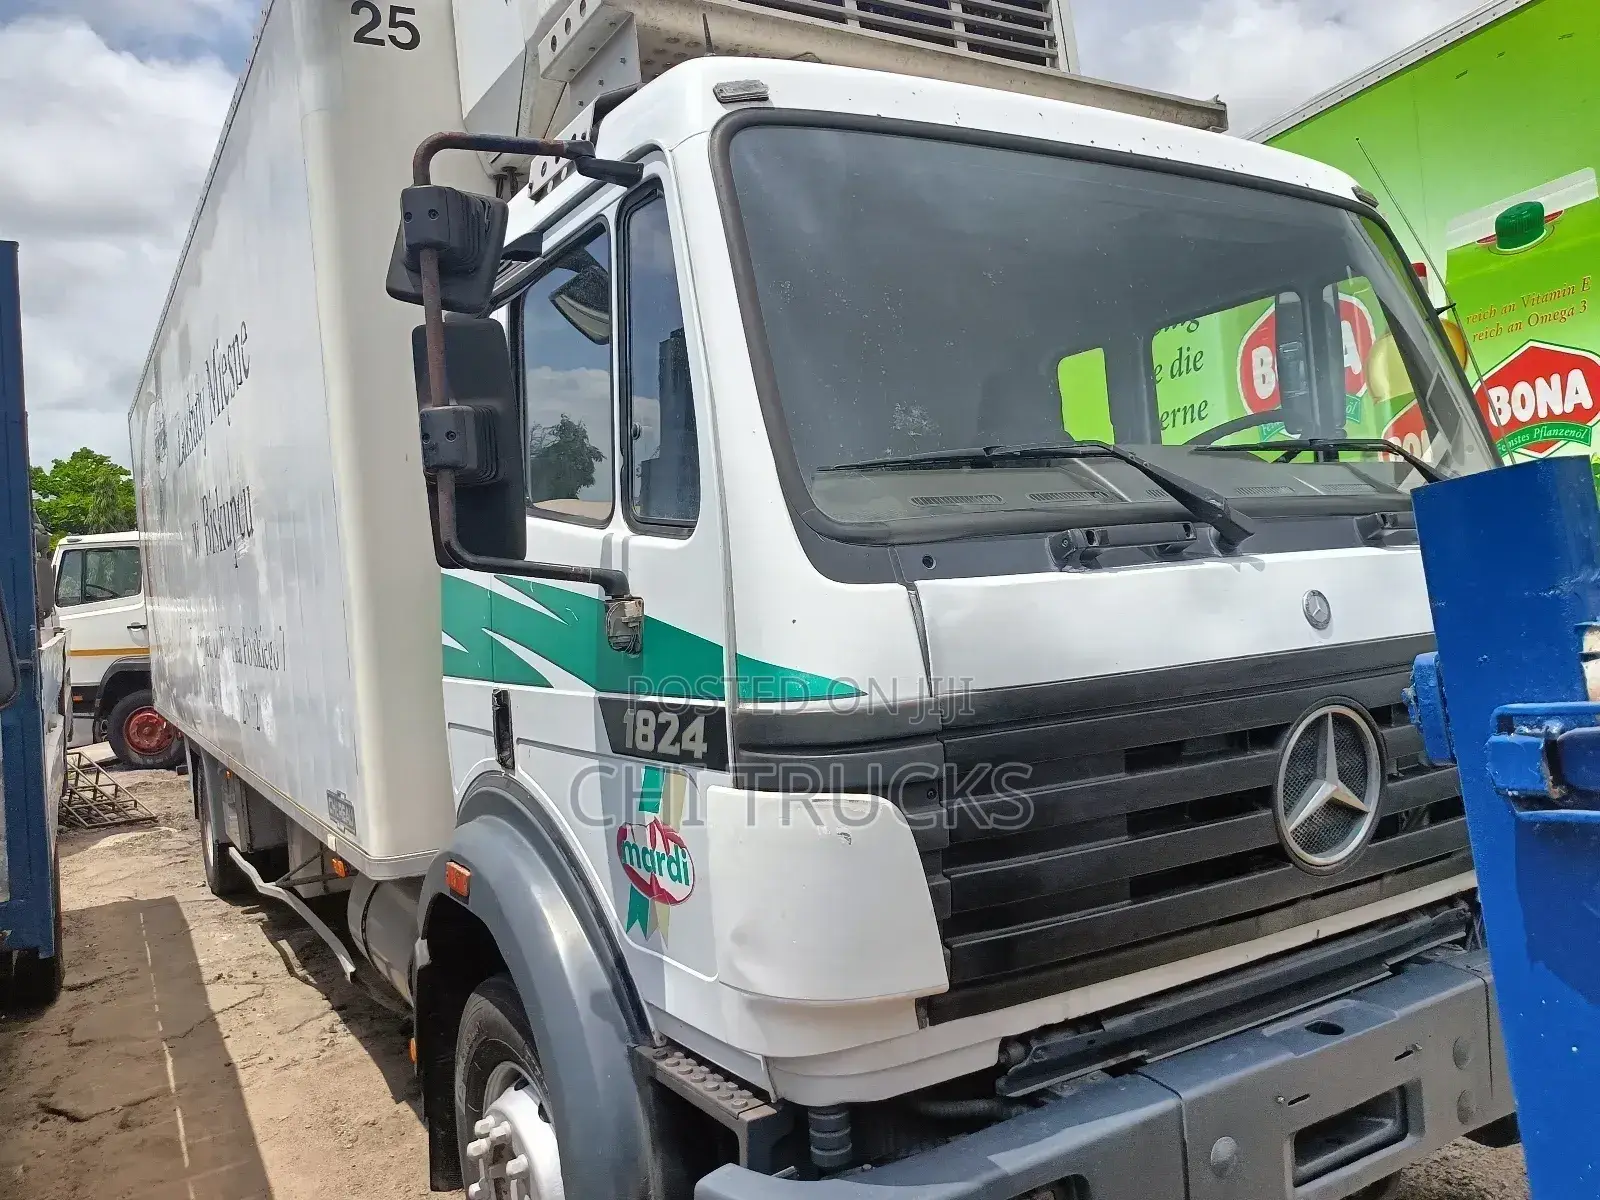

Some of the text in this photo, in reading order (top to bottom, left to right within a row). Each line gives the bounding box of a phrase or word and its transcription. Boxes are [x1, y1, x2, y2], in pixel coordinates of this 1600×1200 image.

[351, 0, 420, 50] 25
[1466, 275, 1591, 324] reich an Vitamin E
[1473, 300, 1587, 342] reich an Omega 3
[1170, 346, 1204, 379] die
[1487, 368, 1593, 428] BONA
[1534, 425, 1588, 440] Pflanzenöl
[623, 708, 708, 760] 1824
[621, 840, 690, 886] mardi
